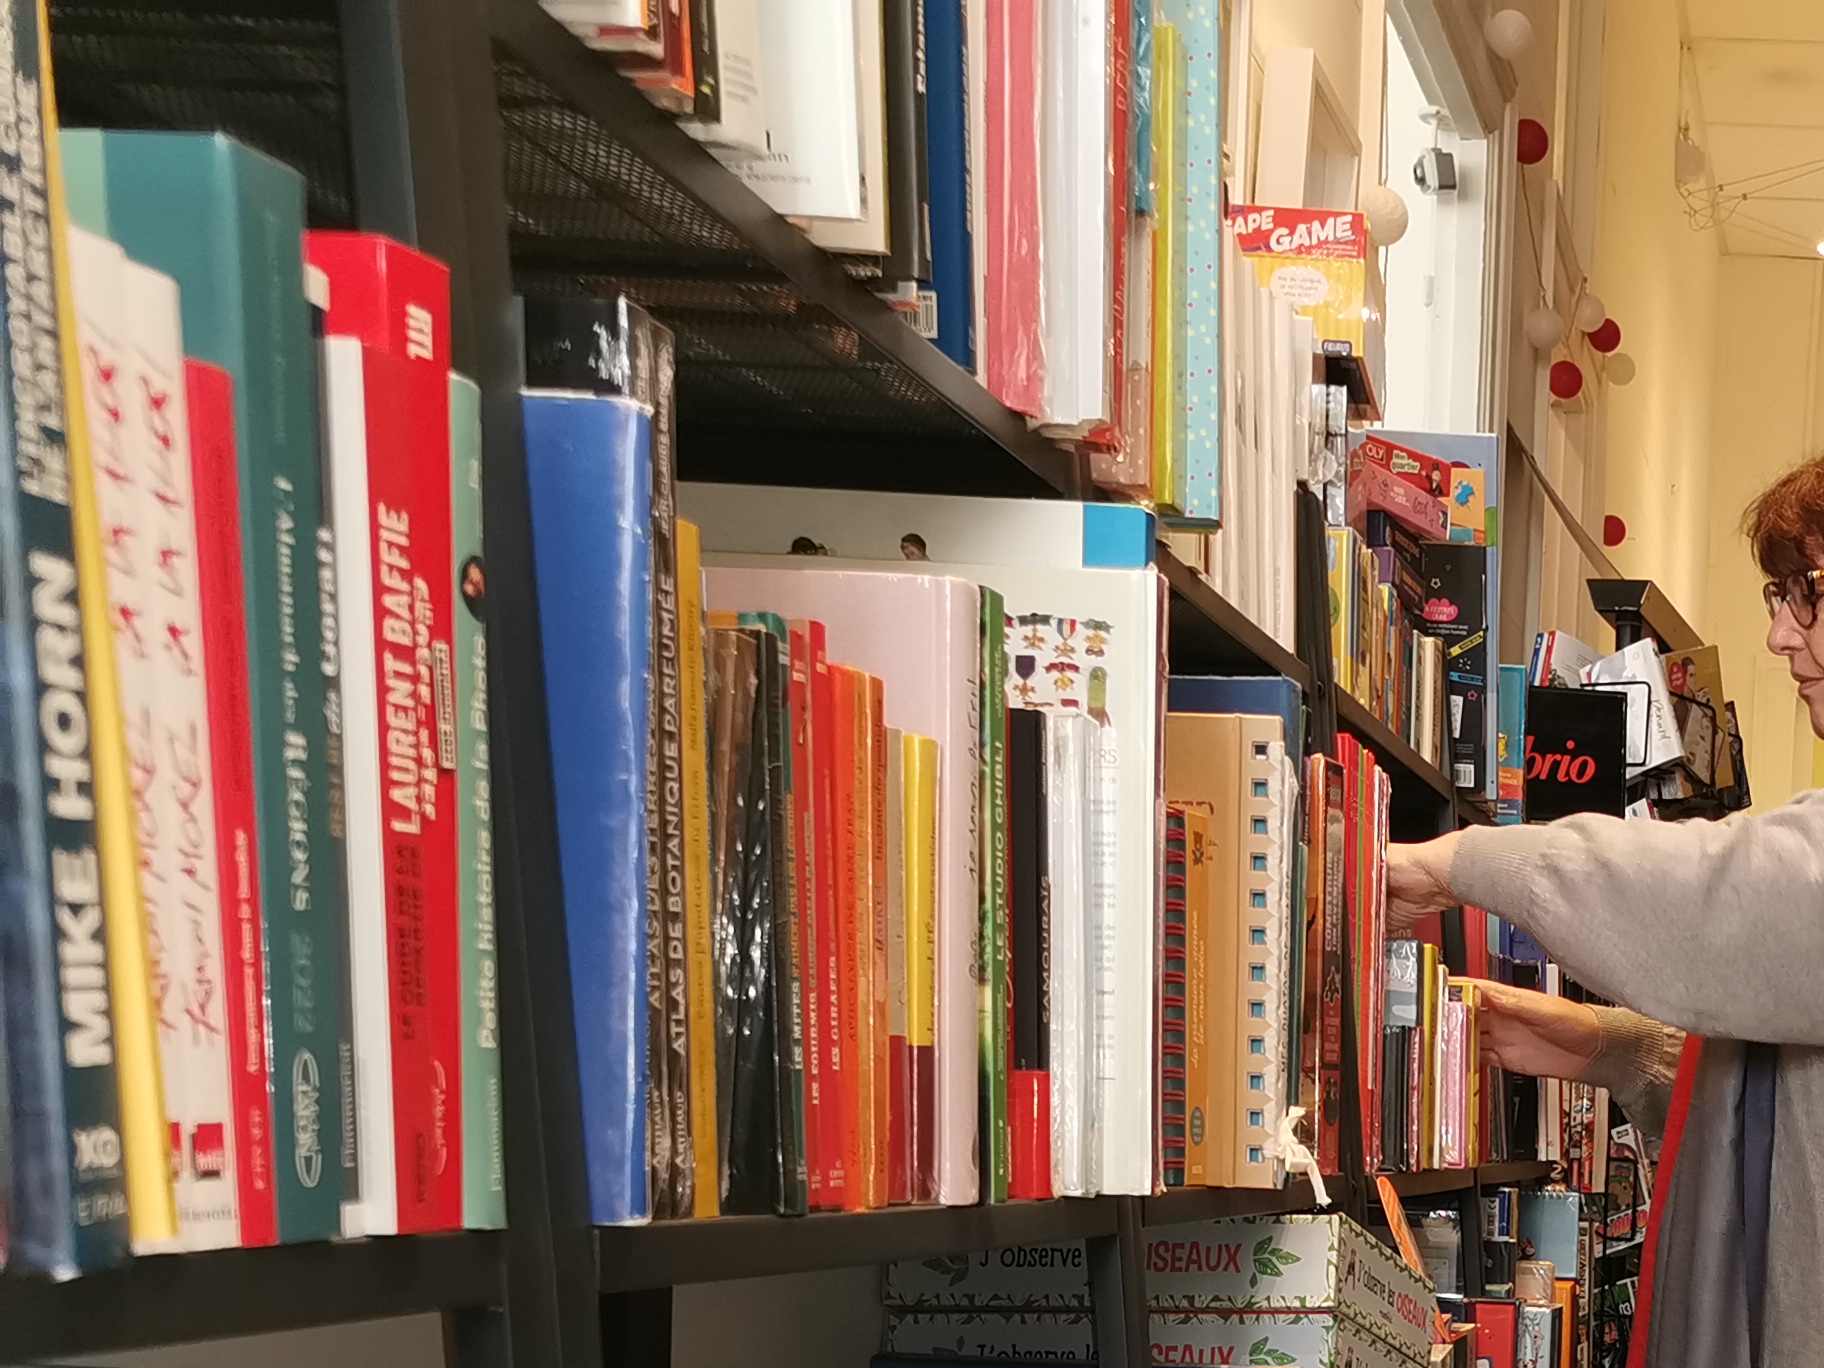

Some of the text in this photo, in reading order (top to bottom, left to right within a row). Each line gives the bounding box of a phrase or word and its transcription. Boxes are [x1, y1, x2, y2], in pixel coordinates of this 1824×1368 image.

[1269, 215, 1353, 252] GAME
[377, 502, 424, 835] LAURENT BAFFIE
[29, 551, 113, 1068] MIKE HORN
[656, 573, 686, 1057] ATLAS DE BOTANIQUE PARFUMÉE
[993, 741, 1005, 960] LE STUDIO GHIBLI
[474, 830, 496, 951] histoire
[1040, 875, 1051, 1023] SAMOURAÏS
[791, 982, 803, 1040] MITES
[829, 956, 840, 1040] GIRAFES
[1146, 1240, 1243, 1273] ISEAUX
[1395, 1291, 1429, 1334] OISEAUX
